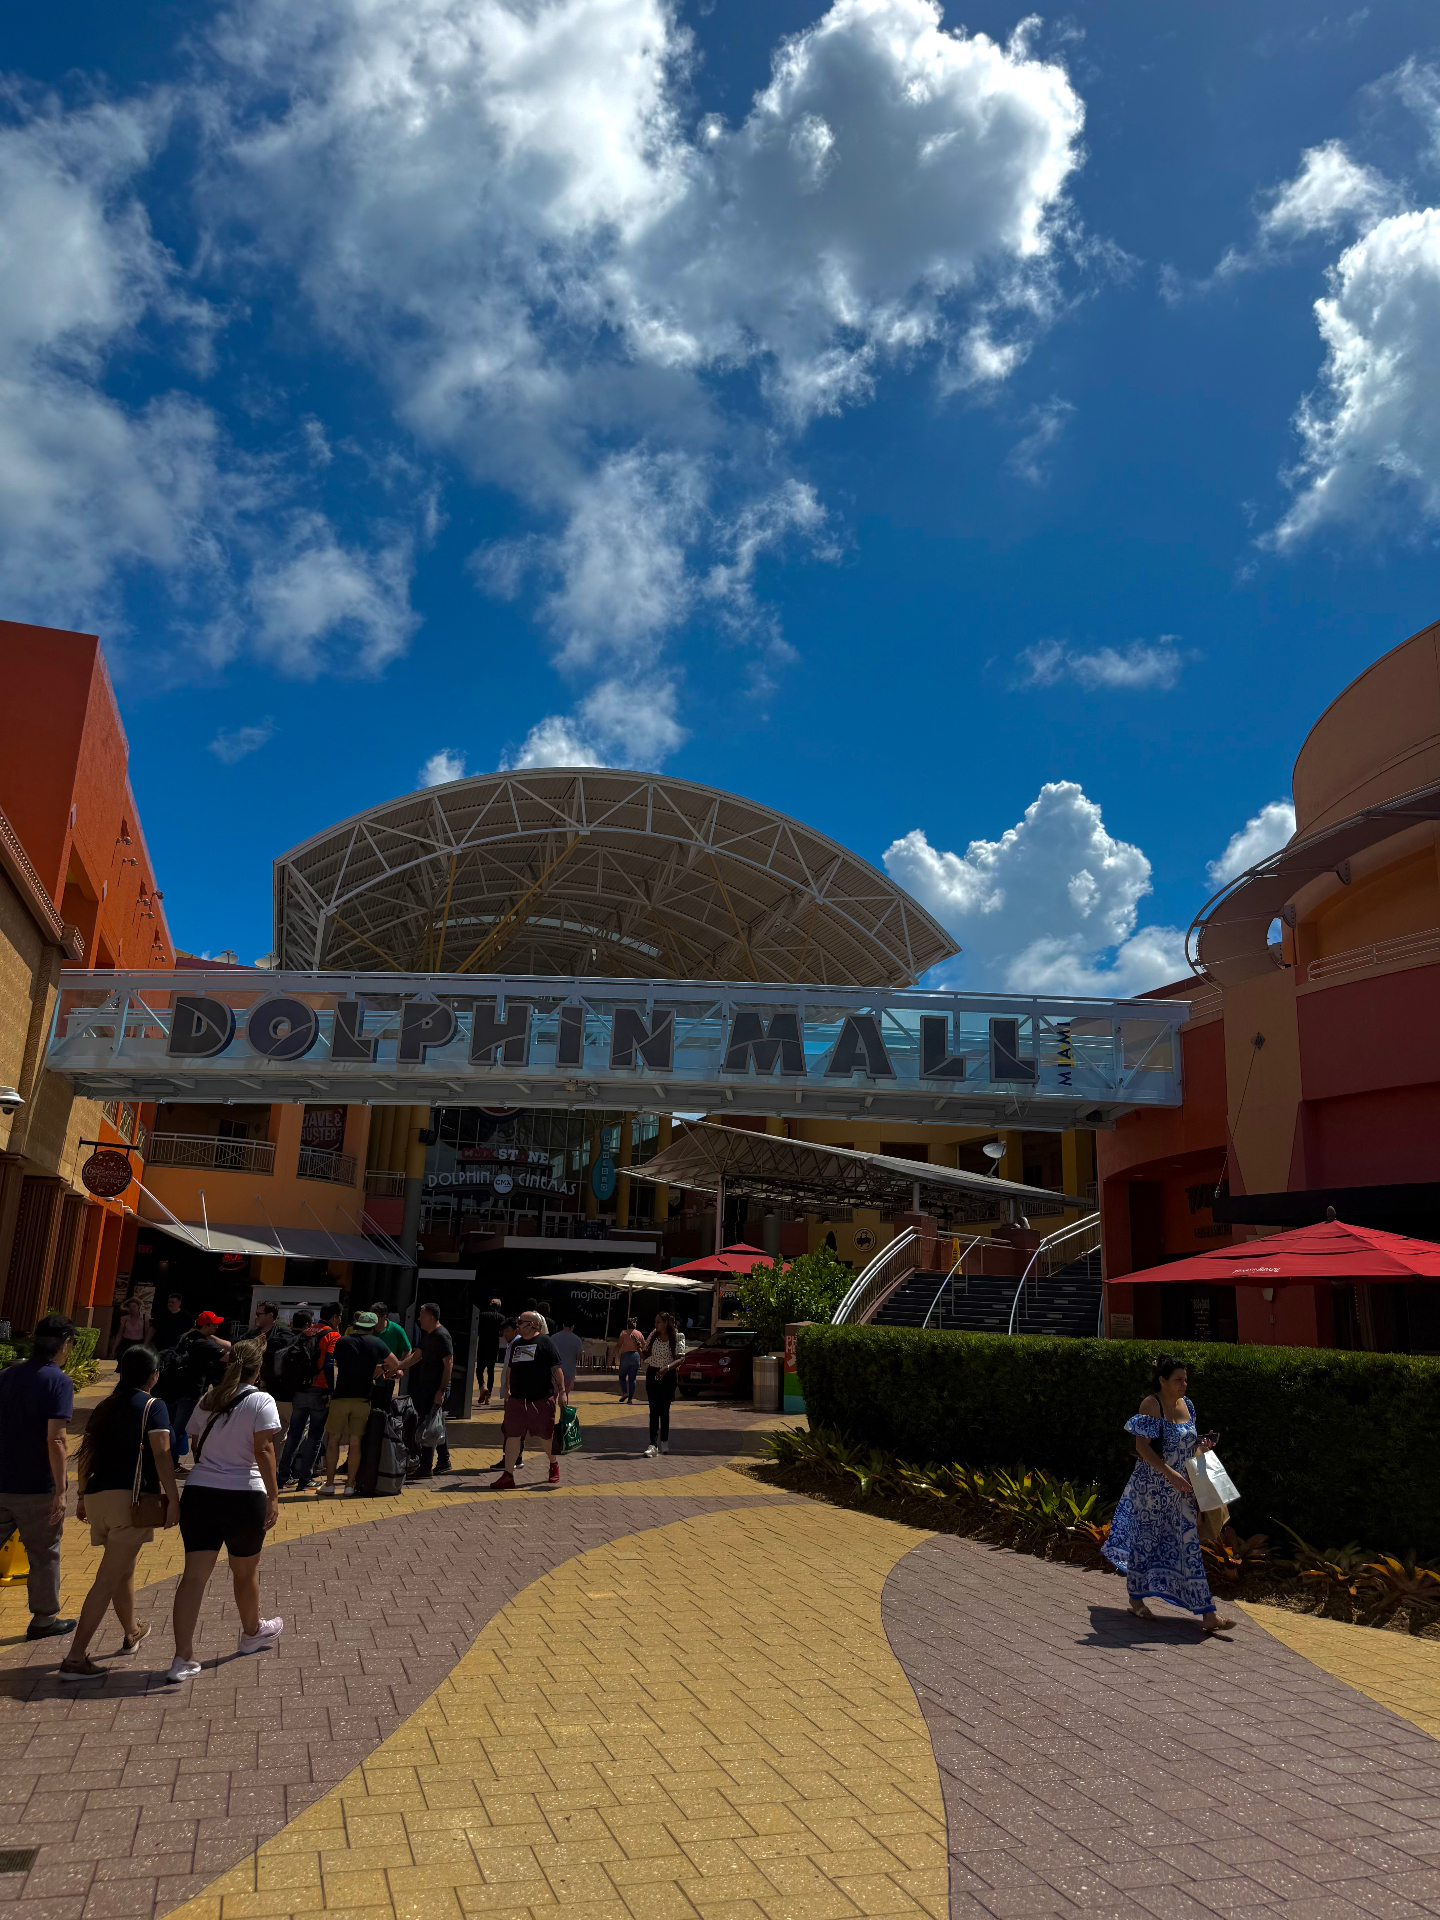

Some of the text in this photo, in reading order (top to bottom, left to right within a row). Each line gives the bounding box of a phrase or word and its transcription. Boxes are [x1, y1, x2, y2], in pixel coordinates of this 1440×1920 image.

[166, 996, 1039, 1084] DOLPHIN MALL
[1056, 1022, 1073, 1087] MIAMI
[334, 1113, 342, 1127] &
[498, 1148, 549, 1165] STONE
[428, 1170, 490, 1188] DOLPHIN
[518, 1172, 577, 1196] CINEMAS
[570, 1287, 621, 1302] mojitobar
